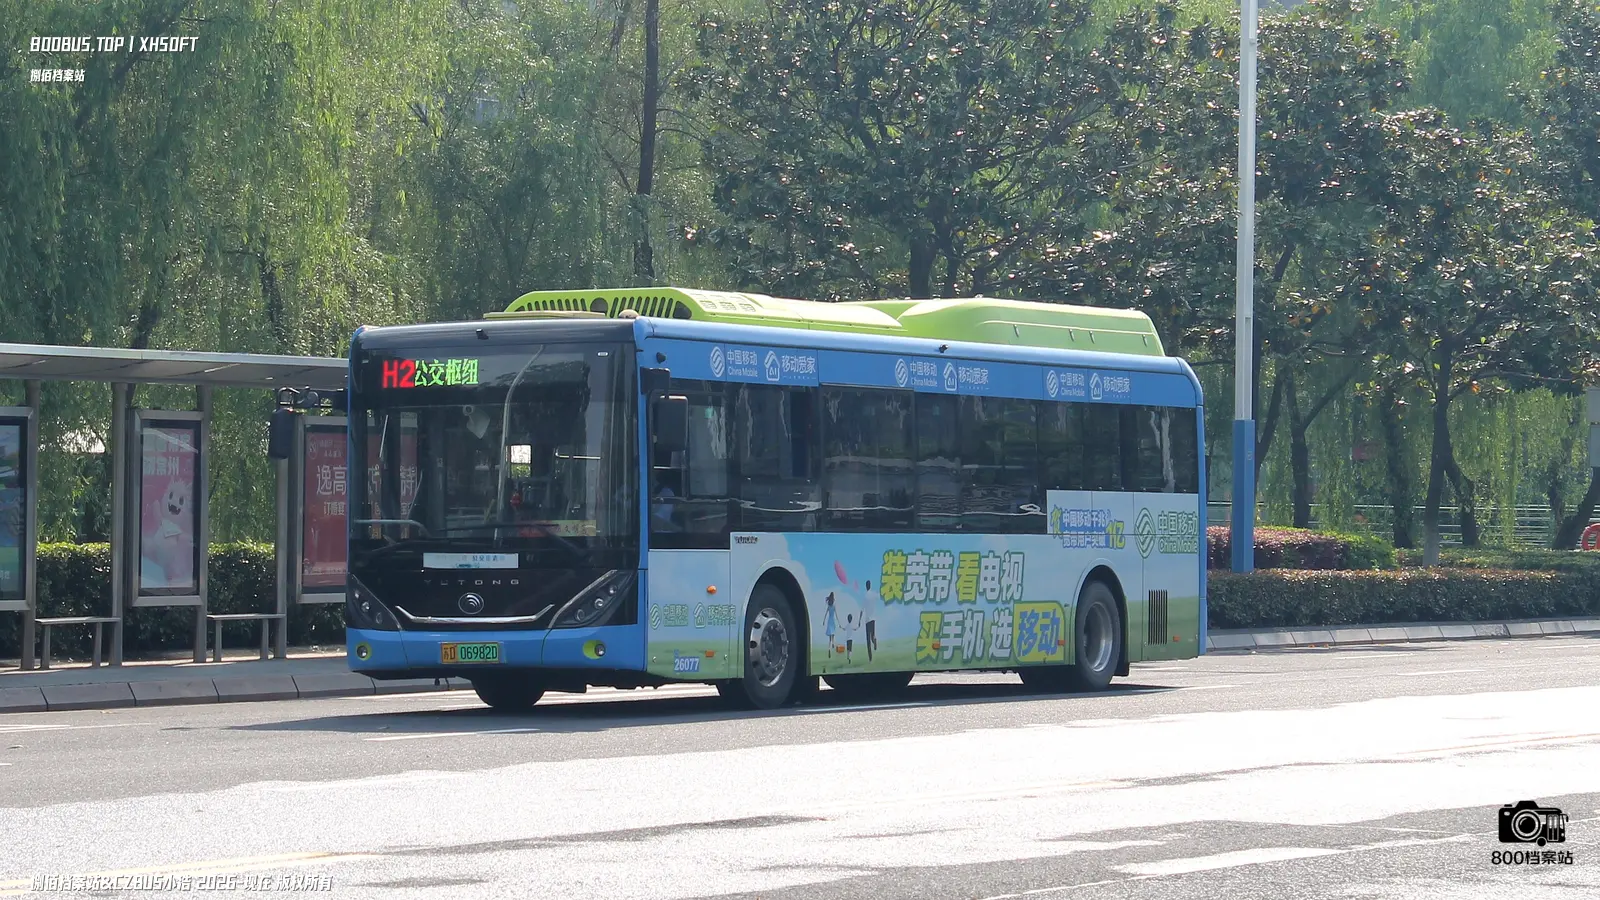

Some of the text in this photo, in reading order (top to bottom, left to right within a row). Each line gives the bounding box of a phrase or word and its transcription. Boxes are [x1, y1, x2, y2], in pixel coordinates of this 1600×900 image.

[727, 349, 758, 366] 中国移动
[781, 355, 816, 374] 移动爱家
[382, 359, 479, 388] H2 公交枢纽
[728, 366, 758, 377] China Mobile
[910, 361, 938, 377] 中国移动
[1060, 373, 1085, 387] 中国移动
[1158, 510, 1199, 535] 中国移动
[1158, 538, 1198, 554] China Mobile
[880, 549, 1025, 605] 装宽带 看电视
[663, 604, 689, 619] 中国移动
[916, 609, 985, 664] 买手机
[674, 658, 700, 671] 26077
